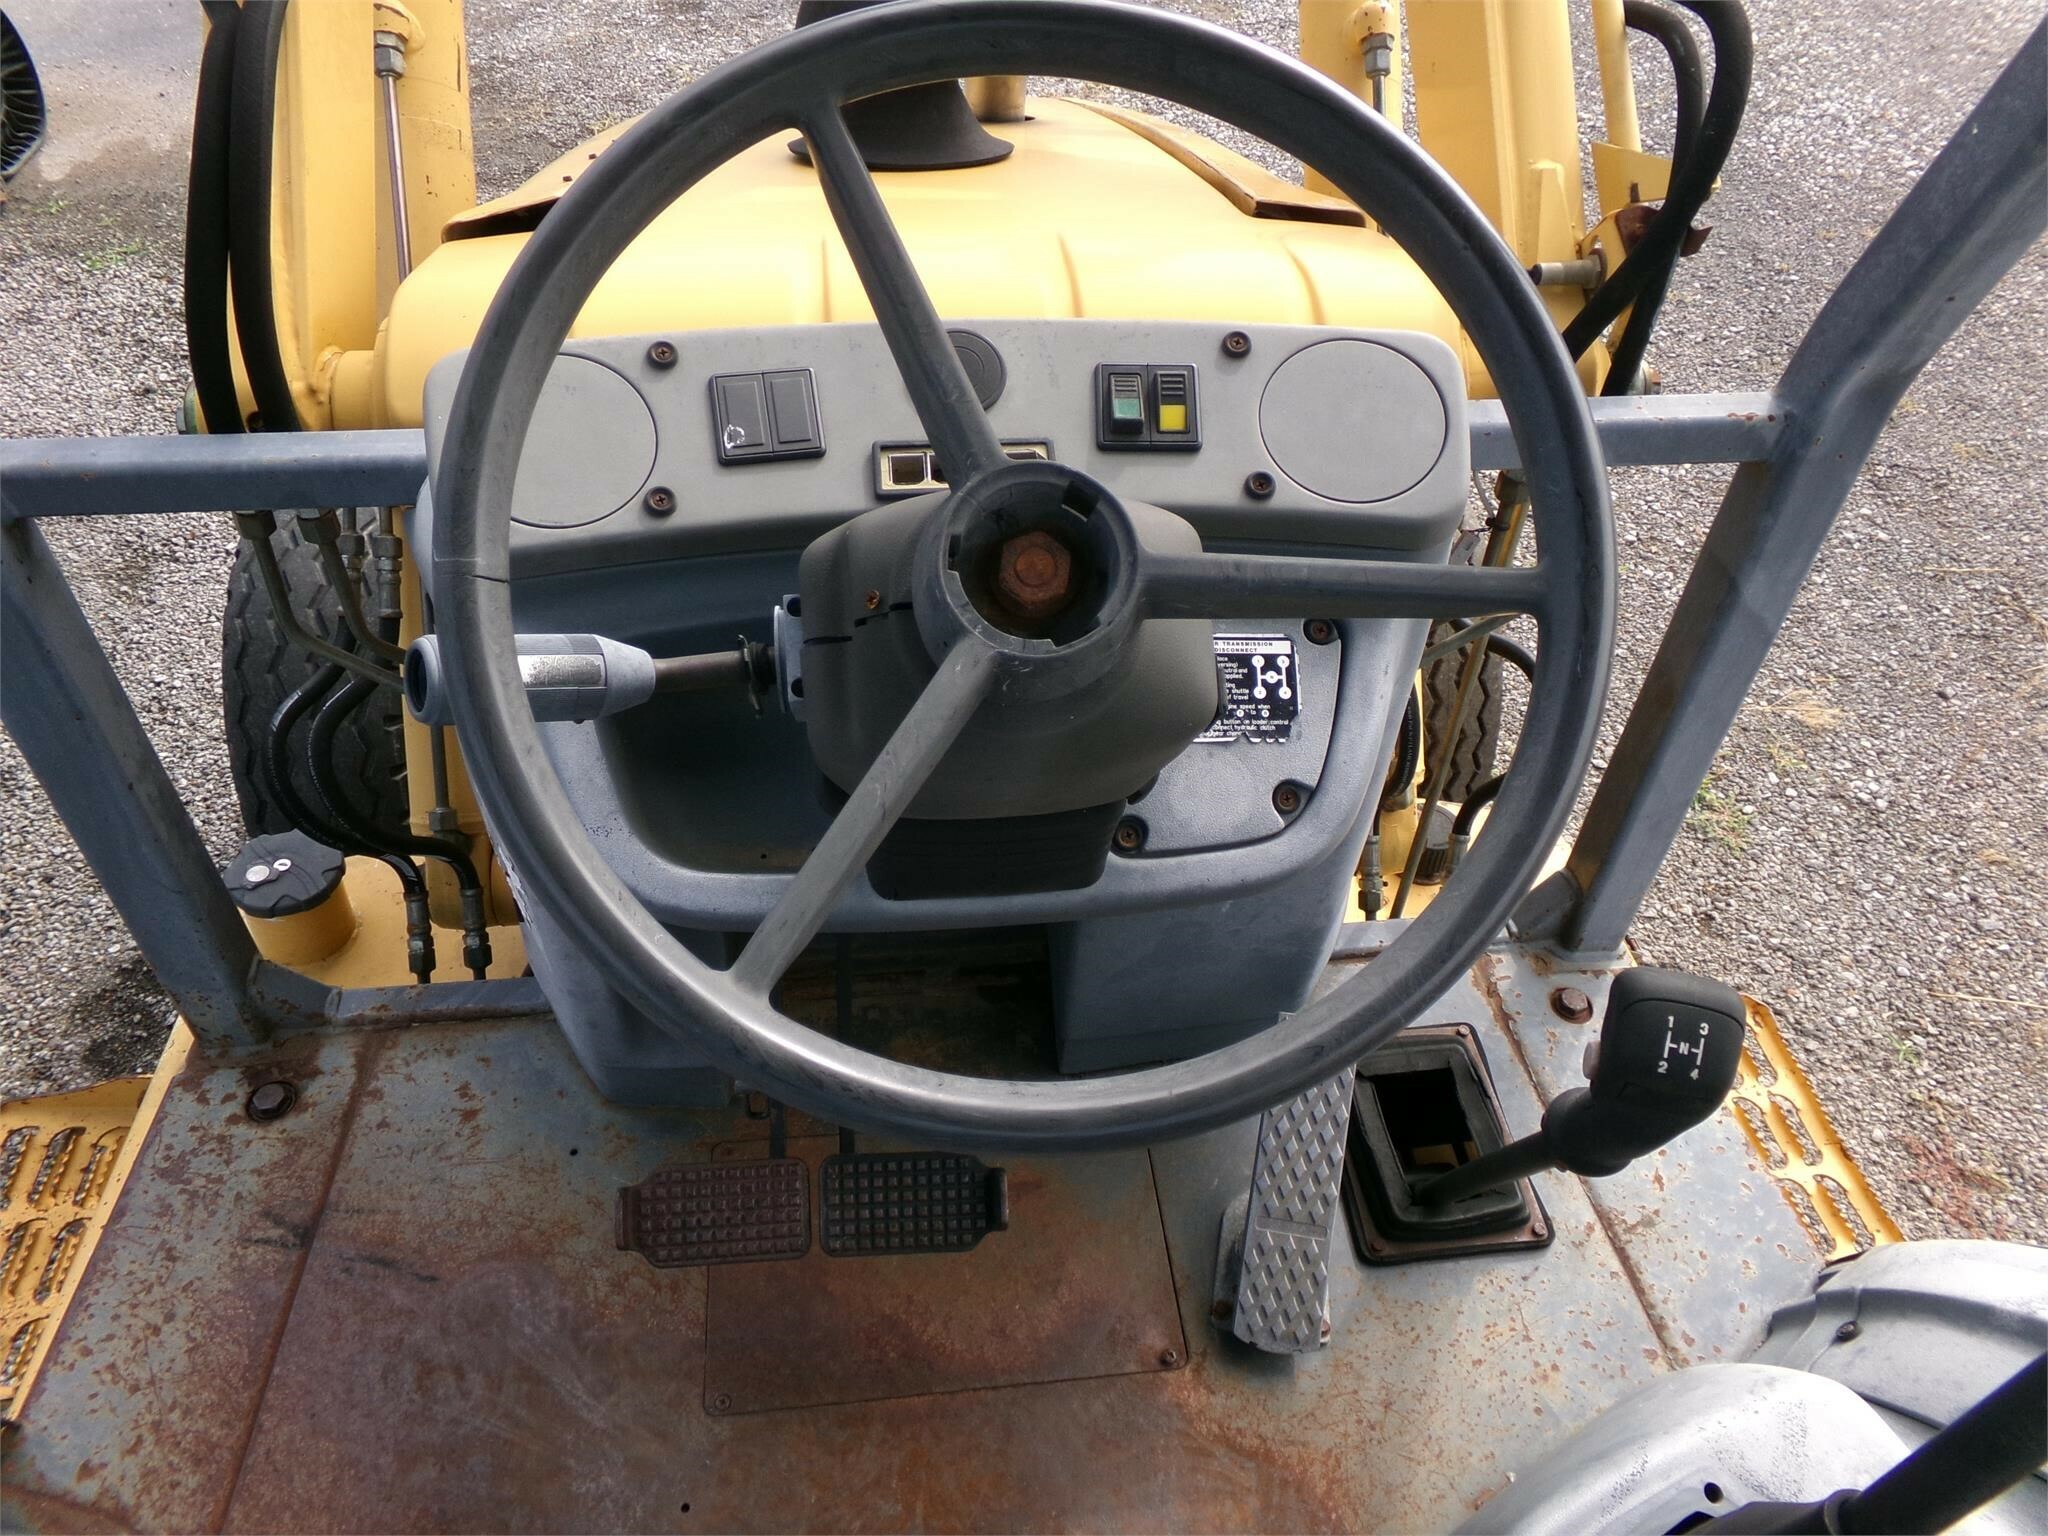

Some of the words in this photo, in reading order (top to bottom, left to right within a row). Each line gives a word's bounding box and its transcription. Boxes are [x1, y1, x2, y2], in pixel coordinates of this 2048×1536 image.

[1668, 1016, 1674, 1028] 1
[1699, 1023, 1709, 1035] 3
[1679, 1041, 1690, 1055] N
[1657, 1061, 1668, 1074] 2
[1690, 1068, 1699, 1080] 4
